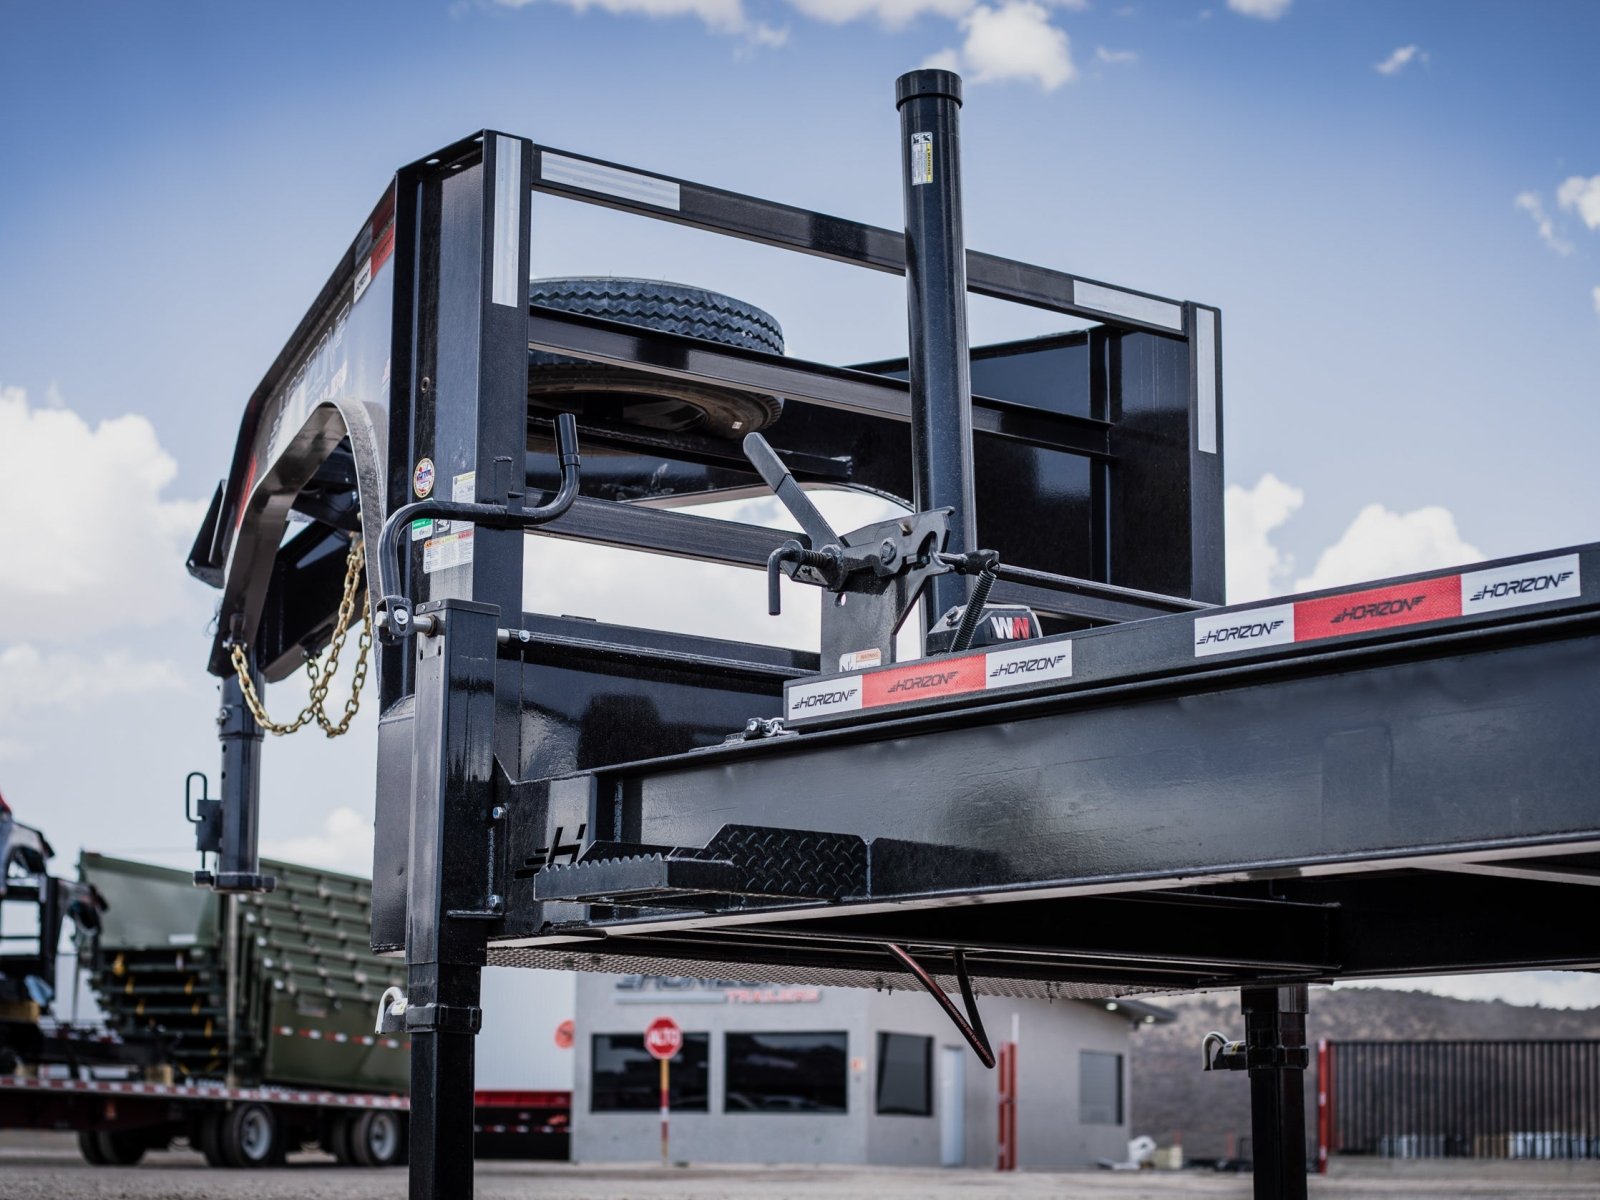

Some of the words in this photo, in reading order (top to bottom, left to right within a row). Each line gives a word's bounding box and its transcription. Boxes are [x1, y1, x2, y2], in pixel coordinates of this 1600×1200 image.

[1476, 573, 1568, 600] HORIZON
[1335, 597, 1420, 622] HORIZON
[1202, 621, 1278, 643] HORIZON
[995, 655, 1061, 677] HORIZON
[892, 671, 954, 692] HORIZON
[795, 689, 854, 709] HORIZON
[649, 1027, 681, 1045] ALTO
